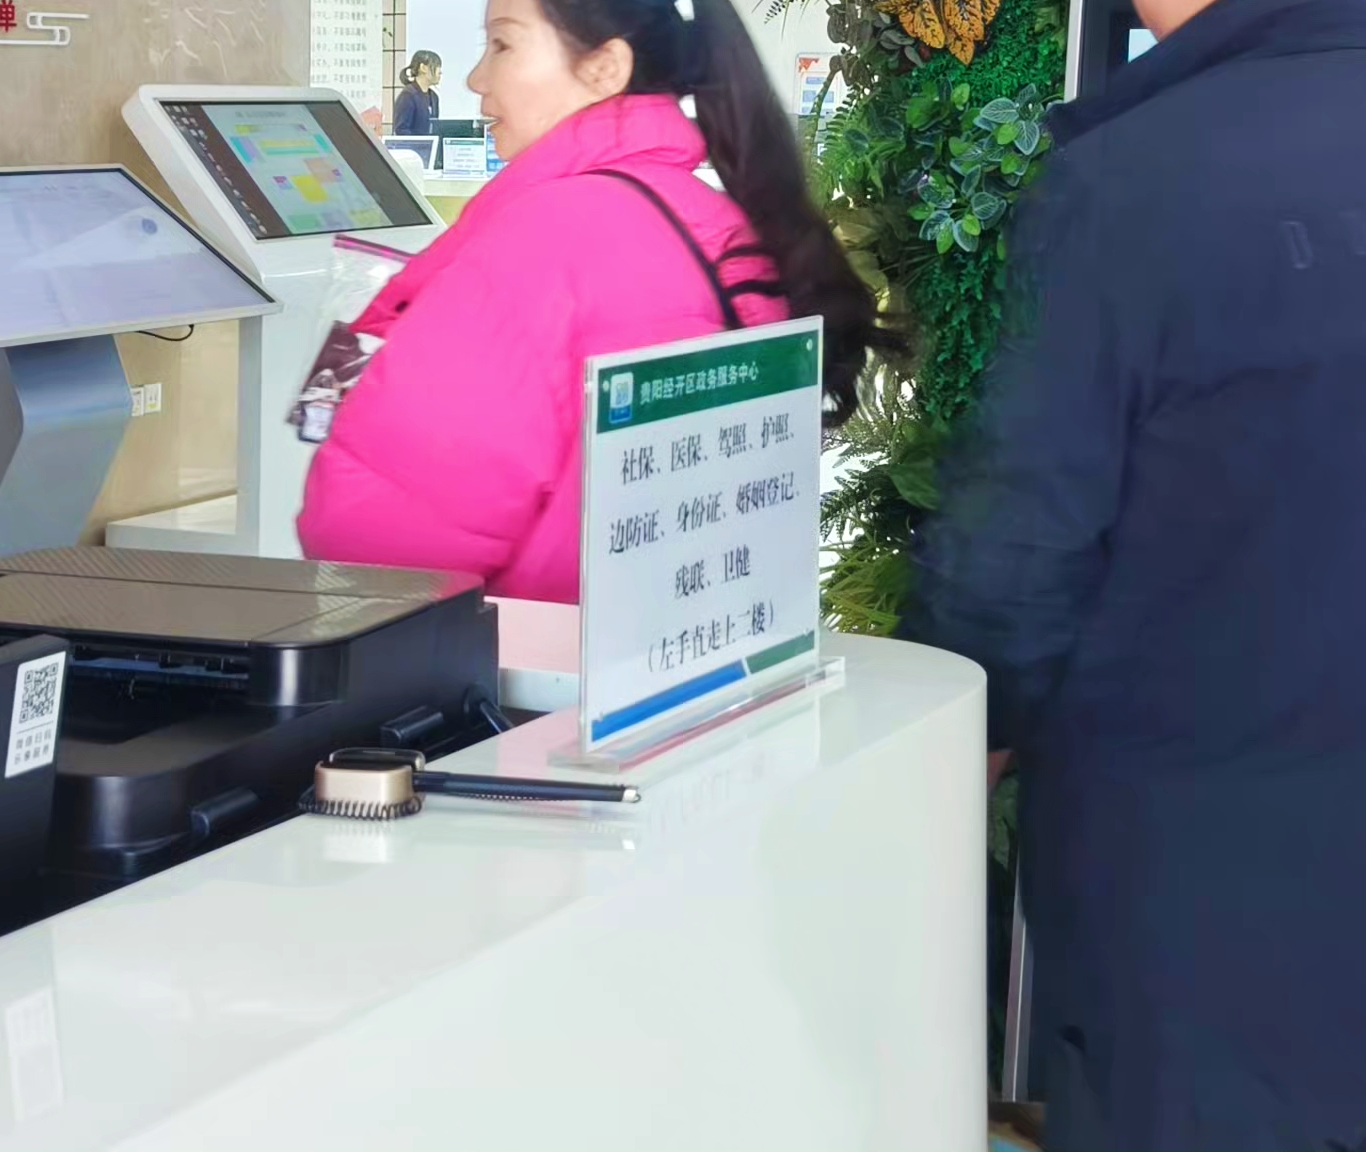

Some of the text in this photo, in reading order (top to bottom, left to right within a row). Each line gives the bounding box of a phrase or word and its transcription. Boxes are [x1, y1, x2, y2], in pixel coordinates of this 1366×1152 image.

[640, 361, 760, 406] 贵阳经开区政务服务中心
